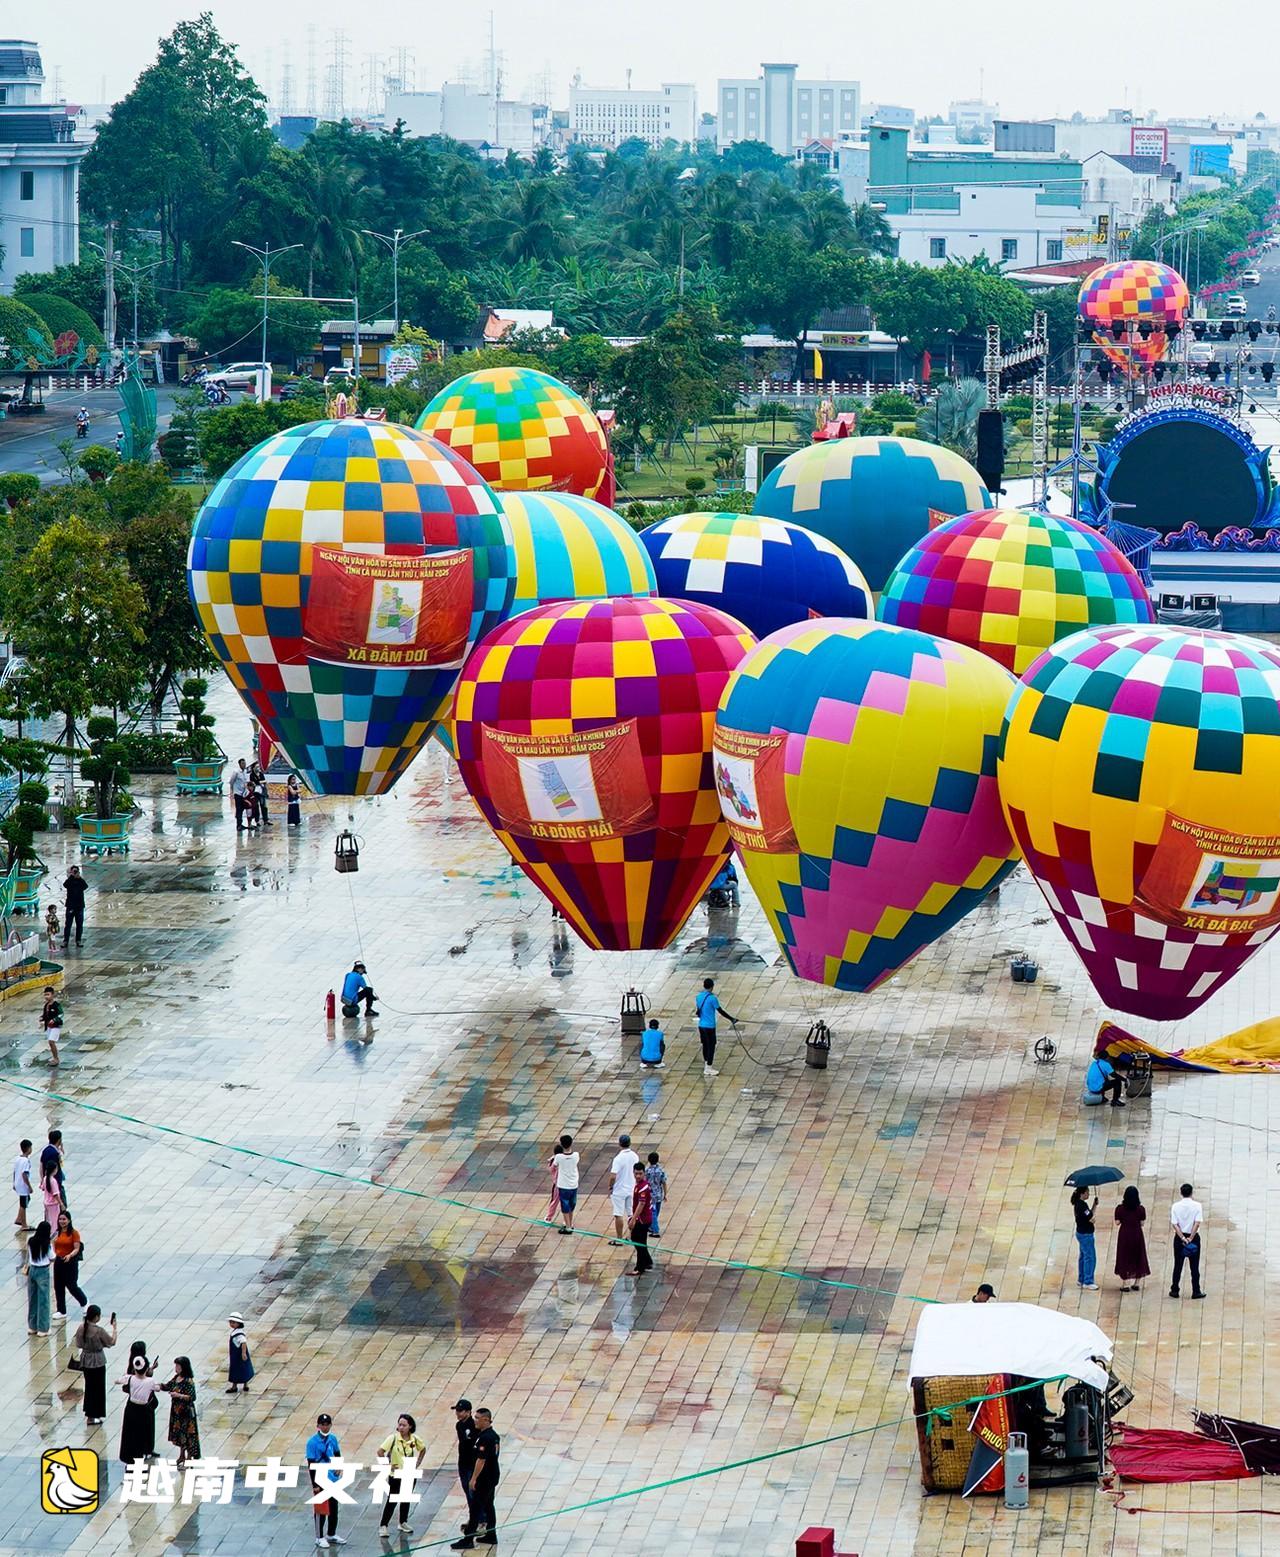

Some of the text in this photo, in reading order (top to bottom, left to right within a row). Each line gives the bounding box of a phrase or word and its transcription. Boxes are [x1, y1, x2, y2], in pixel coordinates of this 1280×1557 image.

[347, 645, 428, 663] XÃ ĐẦM DƠI
[530, 820, 614, 838] XÃ ĐÔNG HẢI
[1184, 916, 1258, 933] XÃ ĐÁ BẠC
